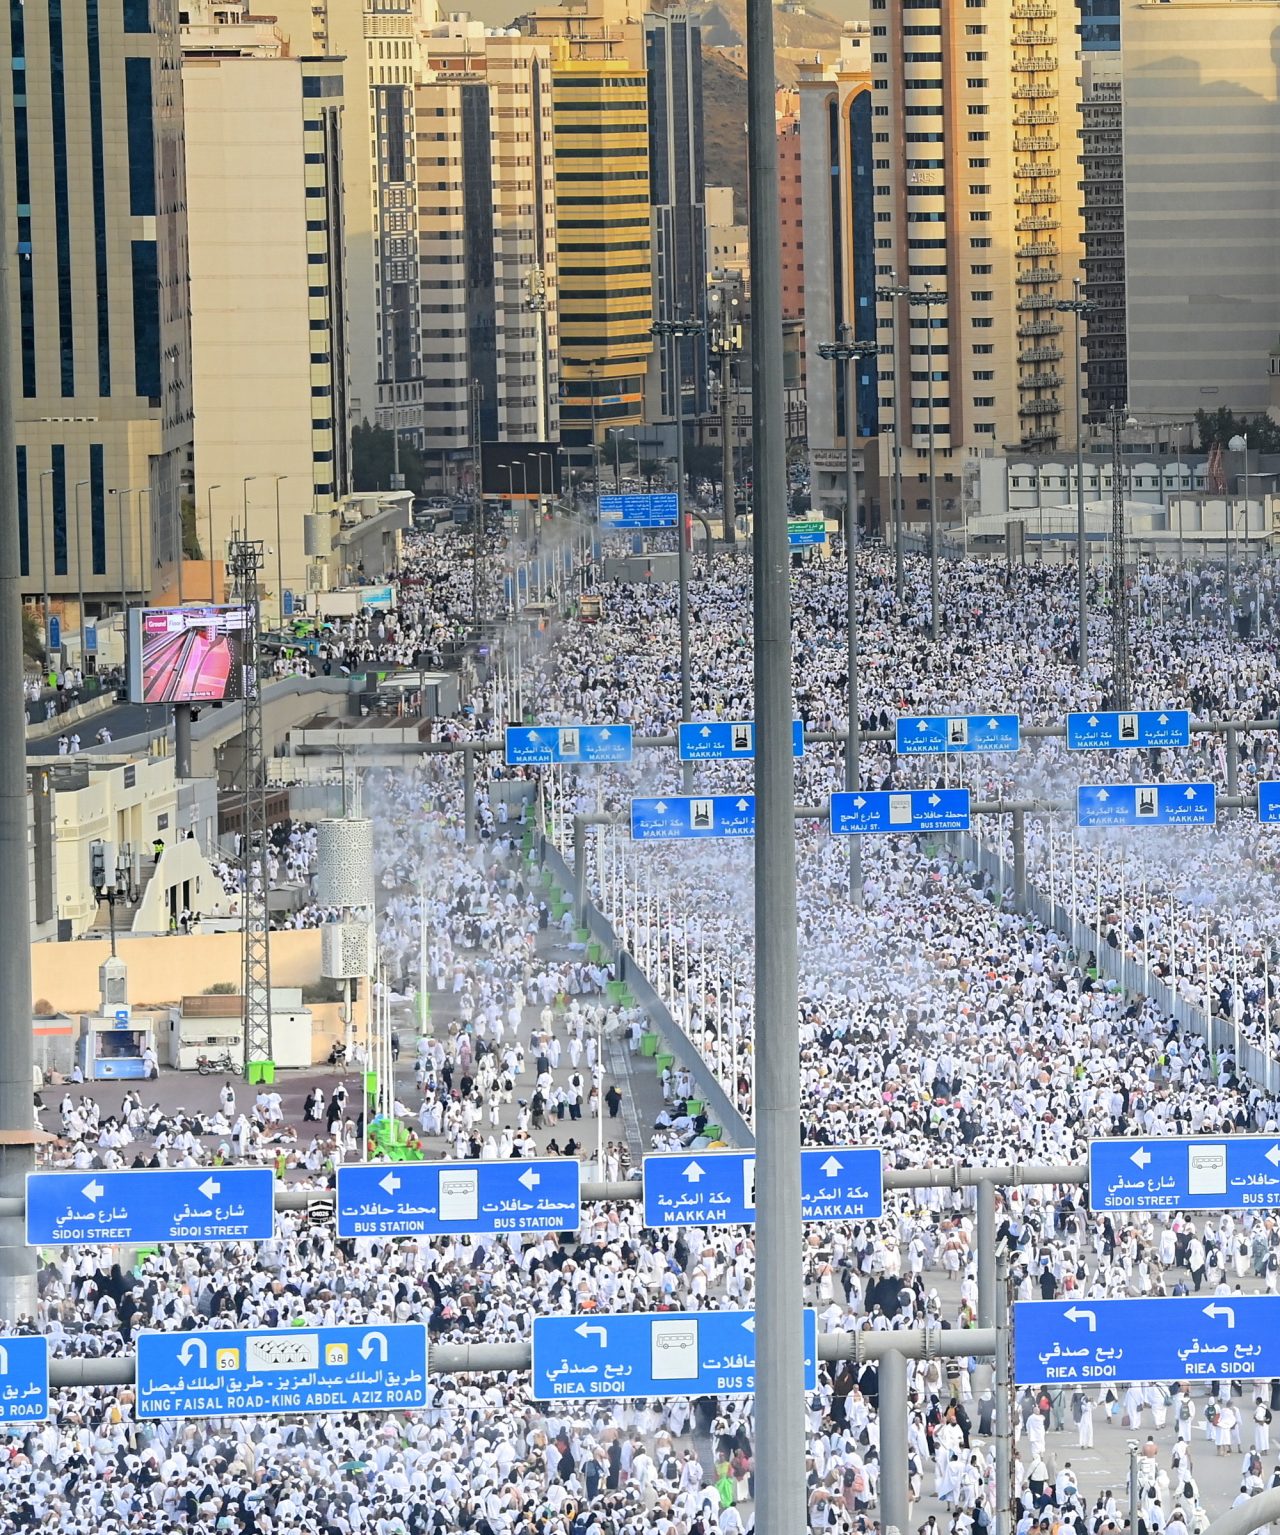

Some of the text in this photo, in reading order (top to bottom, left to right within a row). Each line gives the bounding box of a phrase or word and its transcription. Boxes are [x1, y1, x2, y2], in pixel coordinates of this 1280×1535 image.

[1108, 1176, 1175, 1194] شارع صدقي
[1231, 1173, 1279, 1185] حافلات
[658, 1192, 731, 1208] مكة المكرمة
[801, 1187, 868, 1201] مكة المكرم
[1243, 1194, 1263, 1203] BUS
[483, 1199, 575, 1211] محطة حافلات
[1105, 1196, 1180, 1206] SIDQI STREET
[174, 1204, 244, 1225] شارع صدقي
[342, 1203, 436, 1215] محطة حافلات
[802, 1205, 863, 1216] MAKKAH
[56, 1207, 127, 1227] شارع صدقي
[665, 1210, 725, 1221] MAKKAH
[355, 1221, 424, 1232] BUS STATION
[494, 1217, 563, 1228] BUS STATION
[53, 1228, 131, 1239] SIDQI STREET
[170, 1226, 248, 1236] SIDQI STREET
[1039, 1343, 1122, 1364] ريع صدقي
[1178, 1339, 1261, 1361] ريع صدقي
[221, 1359, 234, 1368] 50
[330, 1354, 343, 1363] 38
[546, 1359, 632, 1381] ريع صدقي
[1047, 1365, 1116, 1377] RIEA SIDQI
[1186, 1362, 1254, 1373] RIEA SIDQI
[187, 1376, 224, 1390] الملك
[346, 1370, 382, 1384] الملك
[385, 1370, 422, 1387] طريق
[718, 1377, 742, 1388] BUS
[142, 1380, 184, 1395] فيصل
[227, 1376, 263, 1393] طريق
[554, 1381, 624, 1393] RIEA SIDQI
[3, 1383, 41, 1400] طريق
[142, 1399, 170, 1411] KING
[176, 1398, 223, 1410] FAISAL
[306, 1393, 347, 1404] ABDEL
[352, 1391, 382, 1403] AZIZ
[387, 1390, 421, 1402] ROAD
[10, 1404, 42, 1415] ROAD
